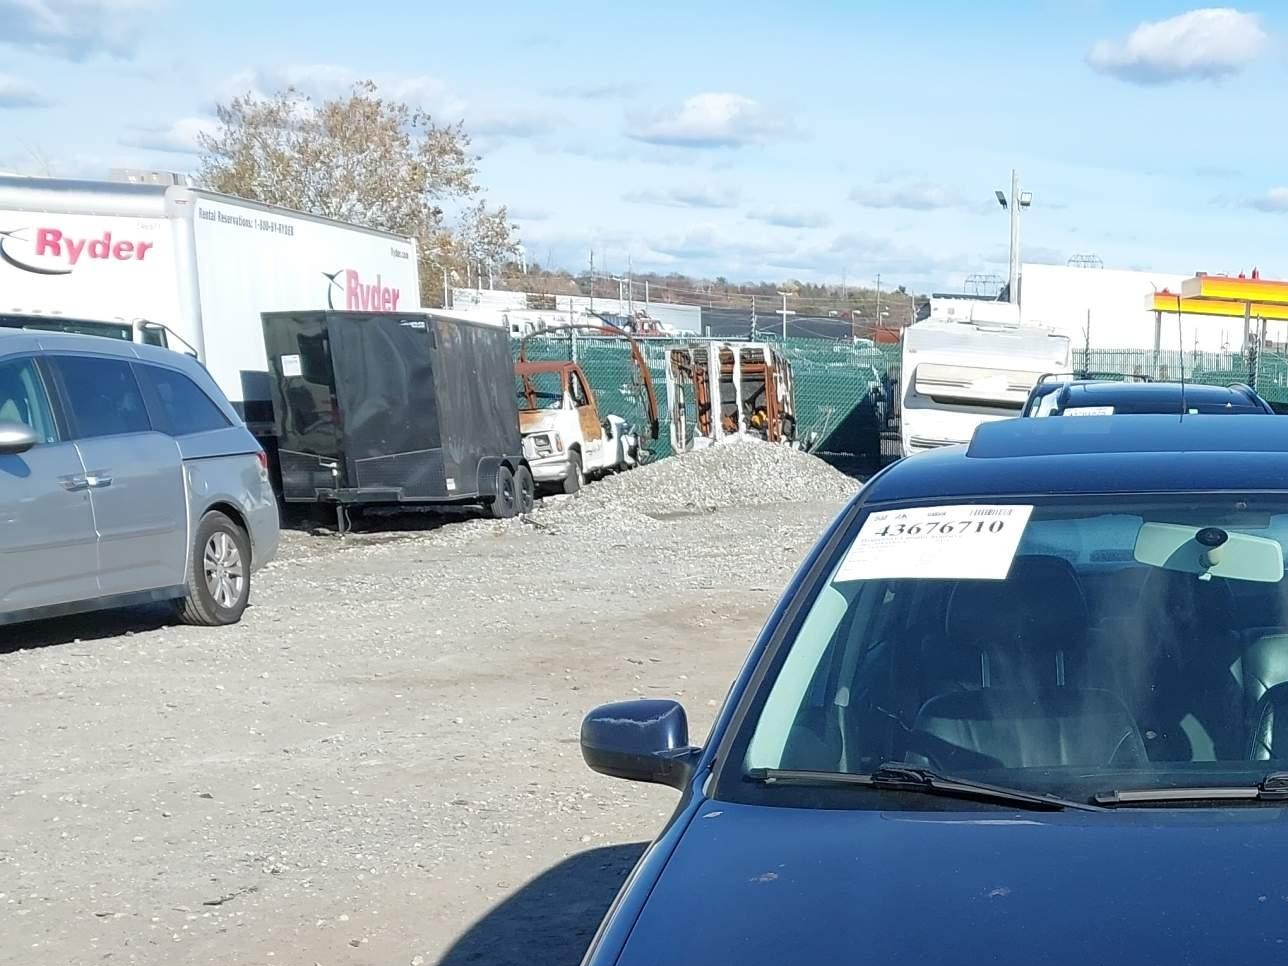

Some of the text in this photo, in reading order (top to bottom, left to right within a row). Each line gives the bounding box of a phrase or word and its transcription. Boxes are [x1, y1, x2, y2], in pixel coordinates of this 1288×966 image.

[199, 207, 216, 221] Rental
[35, 228, 154, 265] Ryder
[874, 520, 1005, 537] 43676710
